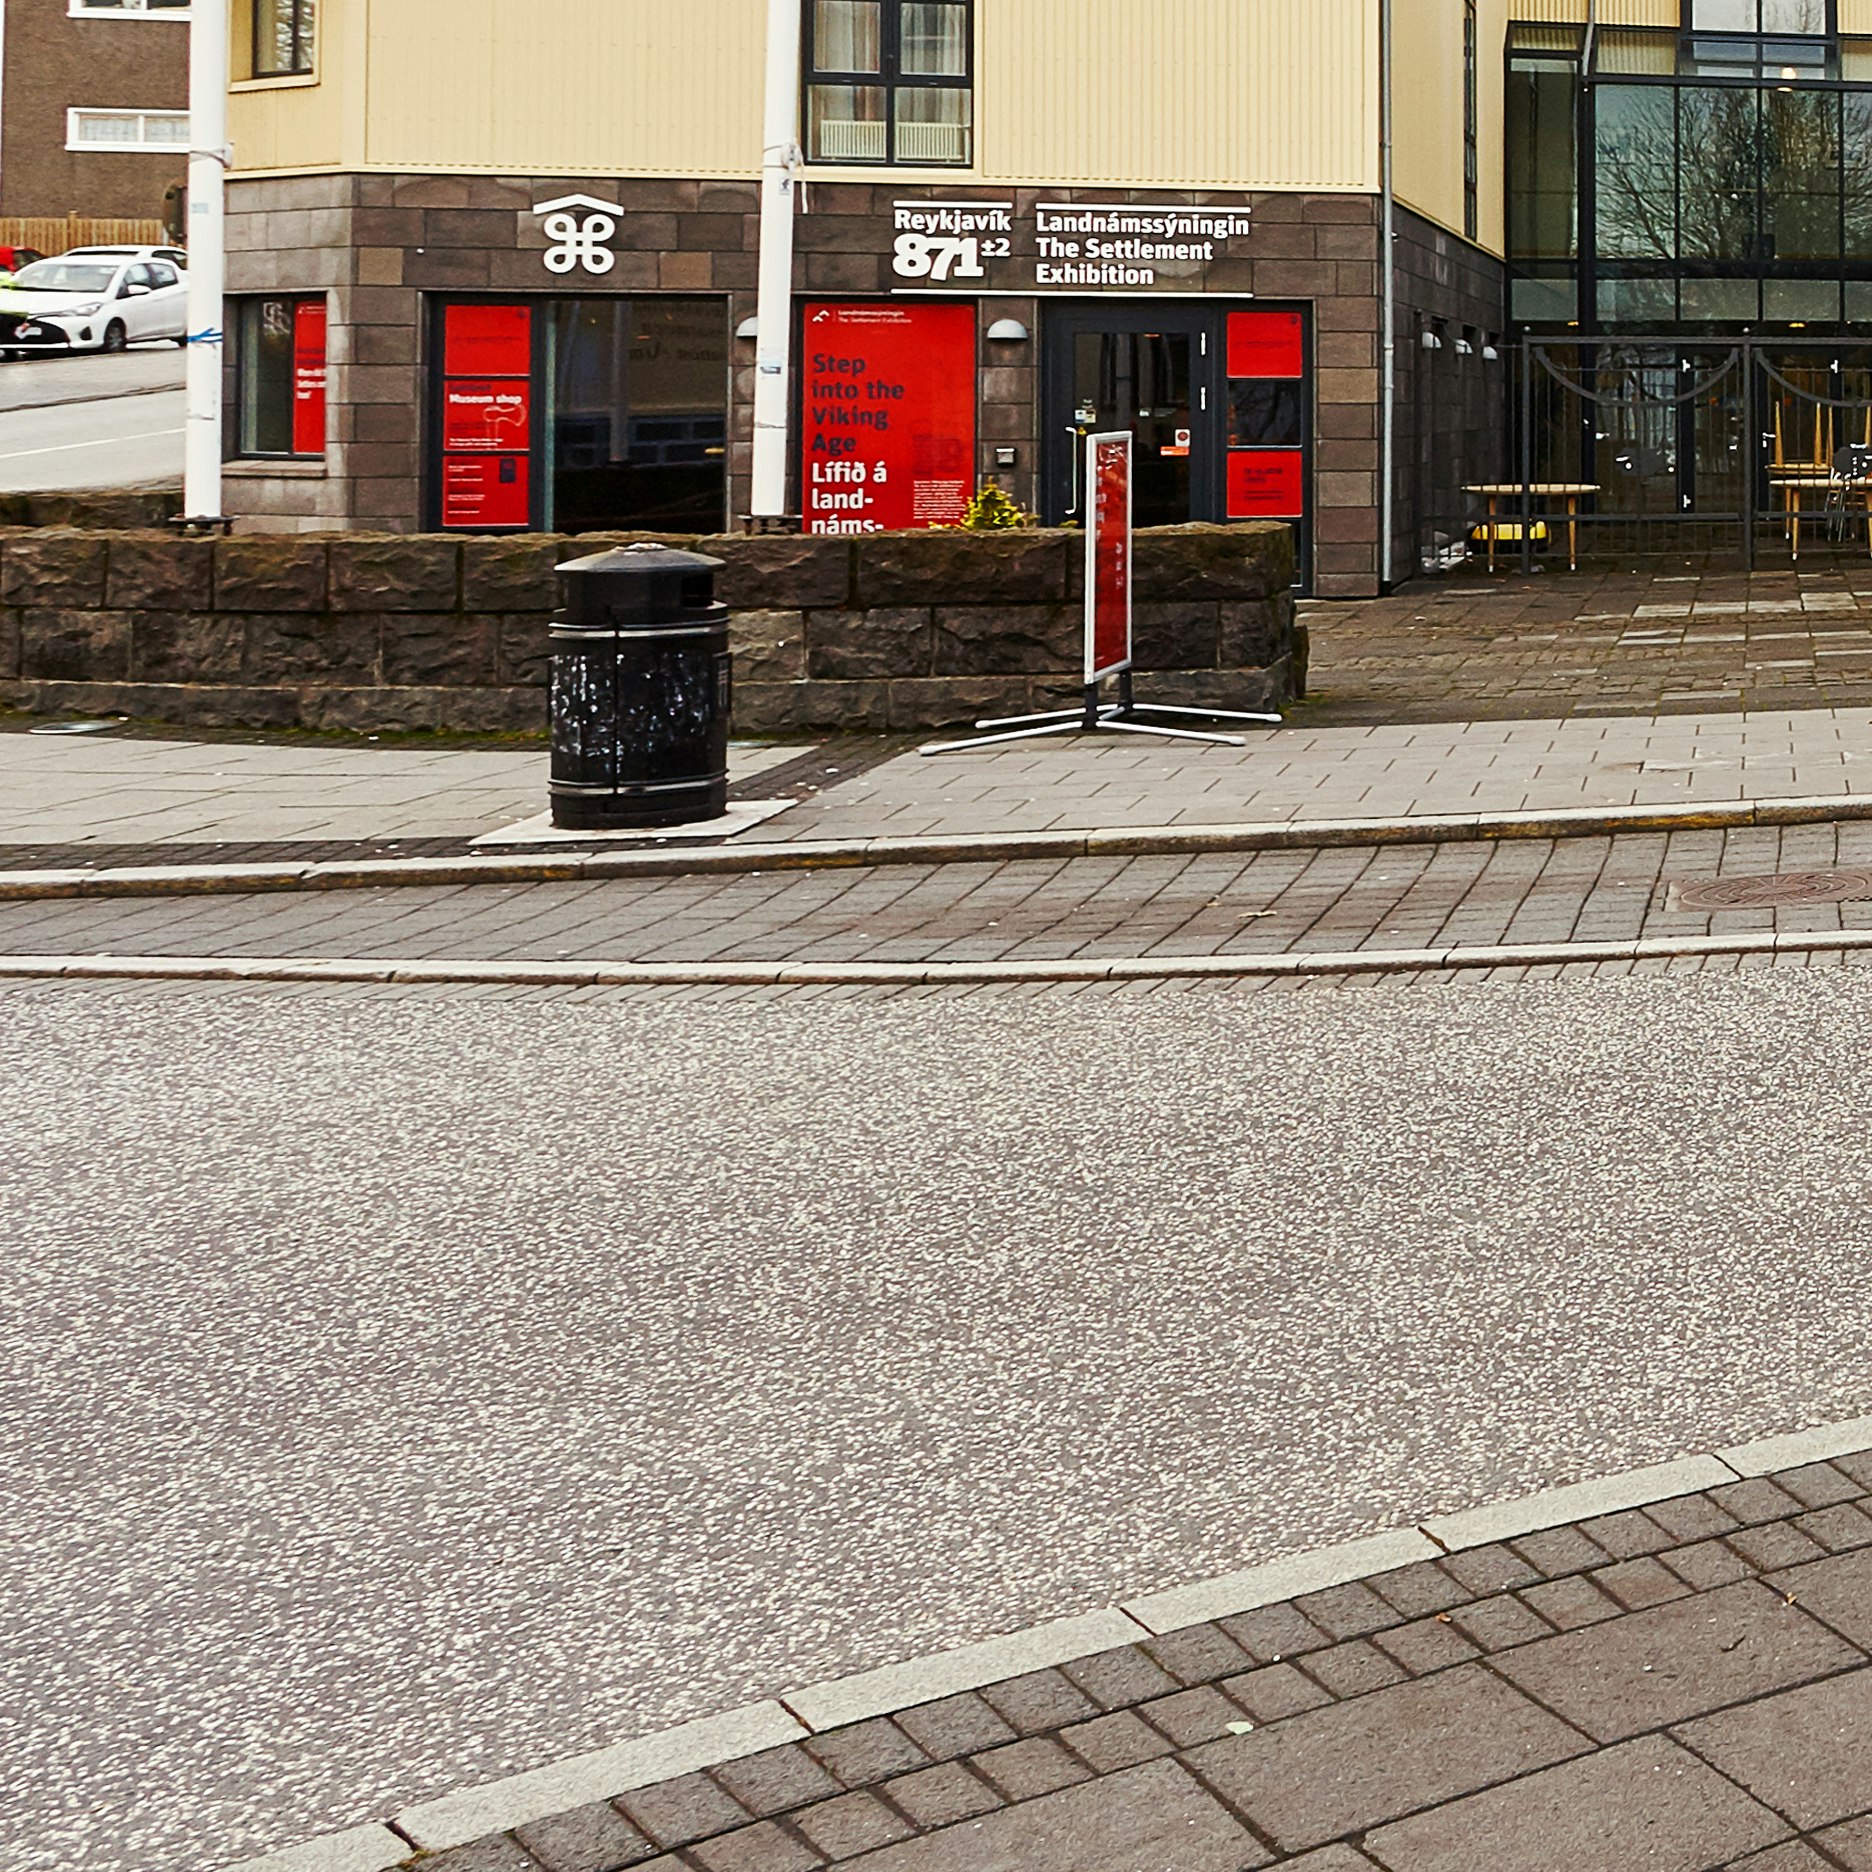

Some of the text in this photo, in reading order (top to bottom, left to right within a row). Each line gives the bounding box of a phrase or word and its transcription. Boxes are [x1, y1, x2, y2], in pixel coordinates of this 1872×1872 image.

[894, 209, 1012, 234] Reykjavík
[1036, 212, 1249, 239] Landnámssýningin
[1036, 237, 1213, 261] The Settlement
[1036, 263, 1154, 285] Exhibition
[813, 353, 866, 376] Step
[449, 393, 522, 405] Museum shop
[812, 380, 905, 400] into the
[812, 406, 889, 430] Viking
[811, 433, 856, 456] Age
[812, 460, 887, 483] Lífið á
[812, 487, 874, 510] land-
[811, 514, 884, 535] náms-
